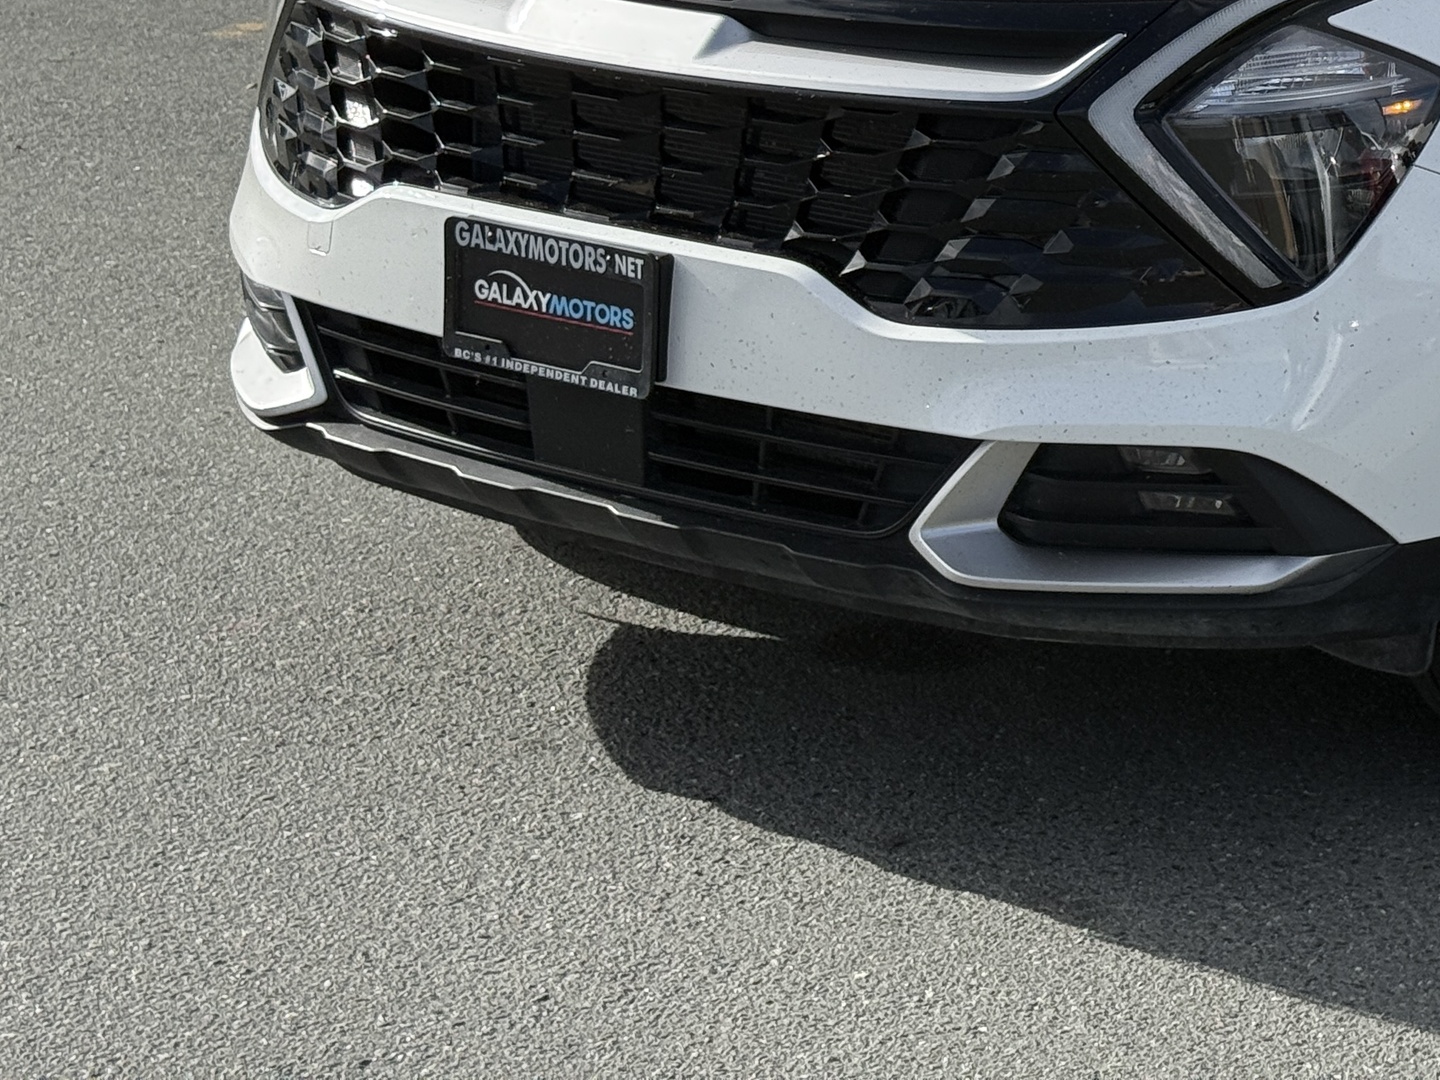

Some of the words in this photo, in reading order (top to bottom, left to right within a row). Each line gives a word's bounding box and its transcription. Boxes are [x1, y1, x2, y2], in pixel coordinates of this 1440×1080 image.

[454, 347, 482, 363] BC'S
[501, 357, 588, 387] INDEPENDENT
[589, 377, 638, 399] DEALER
